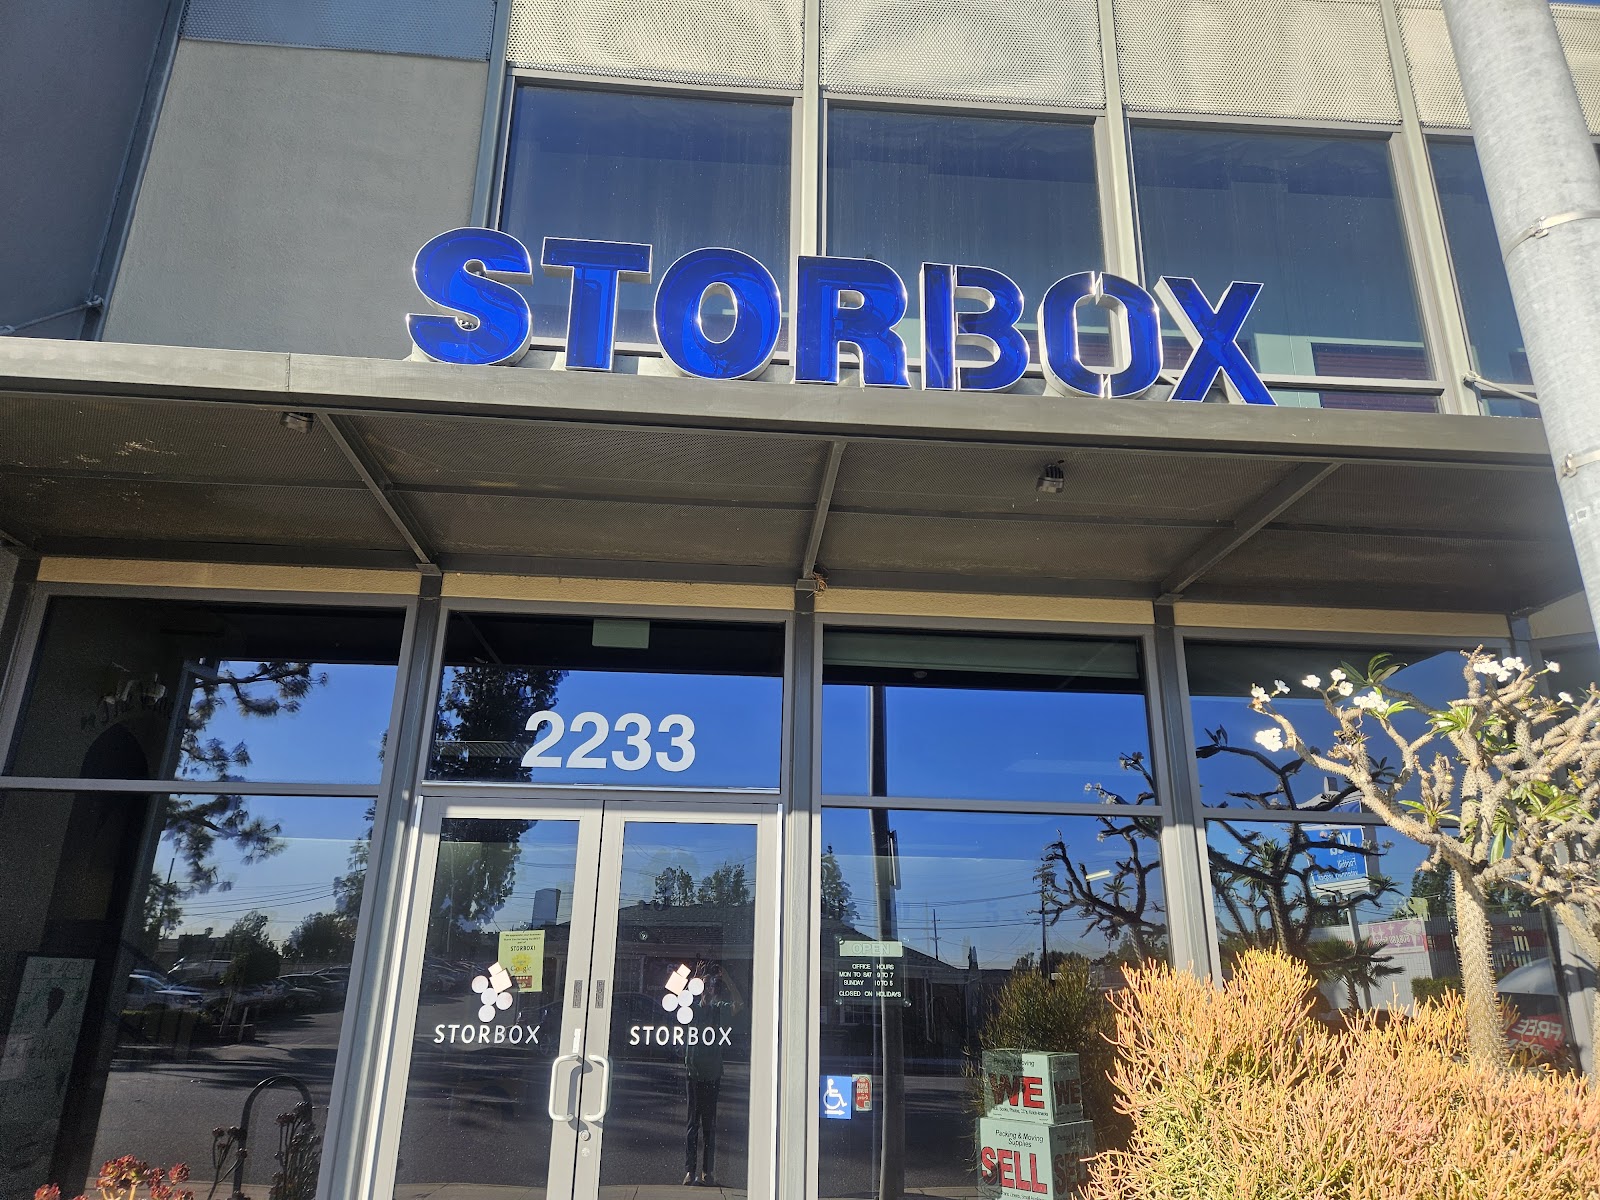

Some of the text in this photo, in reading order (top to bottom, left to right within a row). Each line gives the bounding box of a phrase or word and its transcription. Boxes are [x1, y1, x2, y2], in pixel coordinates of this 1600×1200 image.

[405, 225, 1278, 407] STORBOX
[521, 710, 696, 772] 2233
[851, 943, 891, 955] OPEN
[433, 1024, 541, 1045] STORBOX
[629, 1025, 733, 1047] STORBOX
[988, 1072, 1045, 1109] WE
[995, 1129, 1017, 1140] Packing
[1017, 1132, 1022, 1140] &
[1023, 1132, 1044, 1144] Moving
[1008, 1137, 1032, 1148] Supplies
[981, 1146, 1047, 1194] SELL
